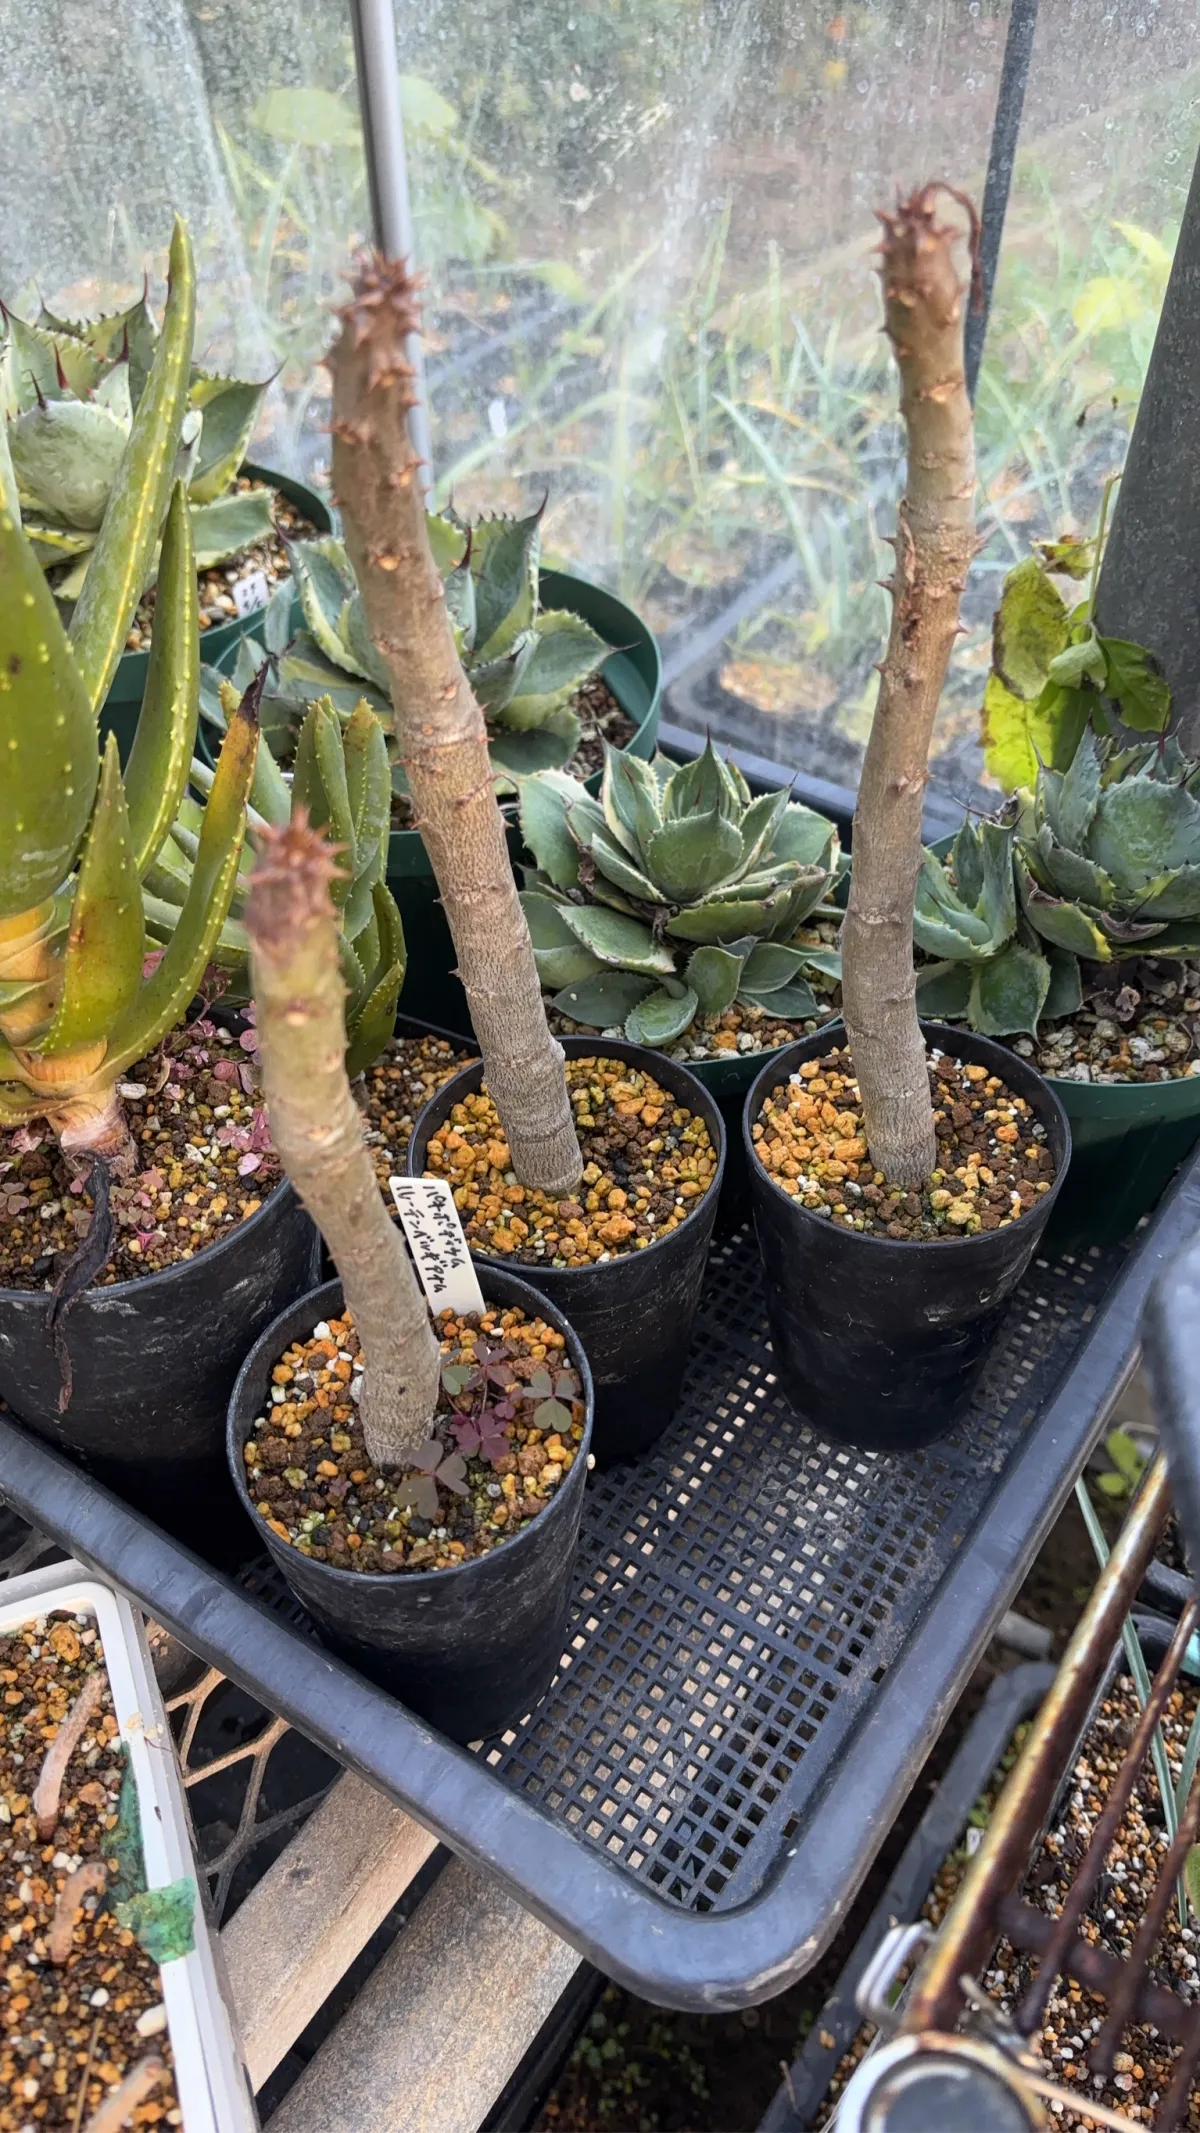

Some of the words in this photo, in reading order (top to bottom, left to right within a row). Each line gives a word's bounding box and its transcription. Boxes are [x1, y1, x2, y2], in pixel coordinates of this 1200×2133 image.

[423, 1185, 466, 1269] パキポディウム
